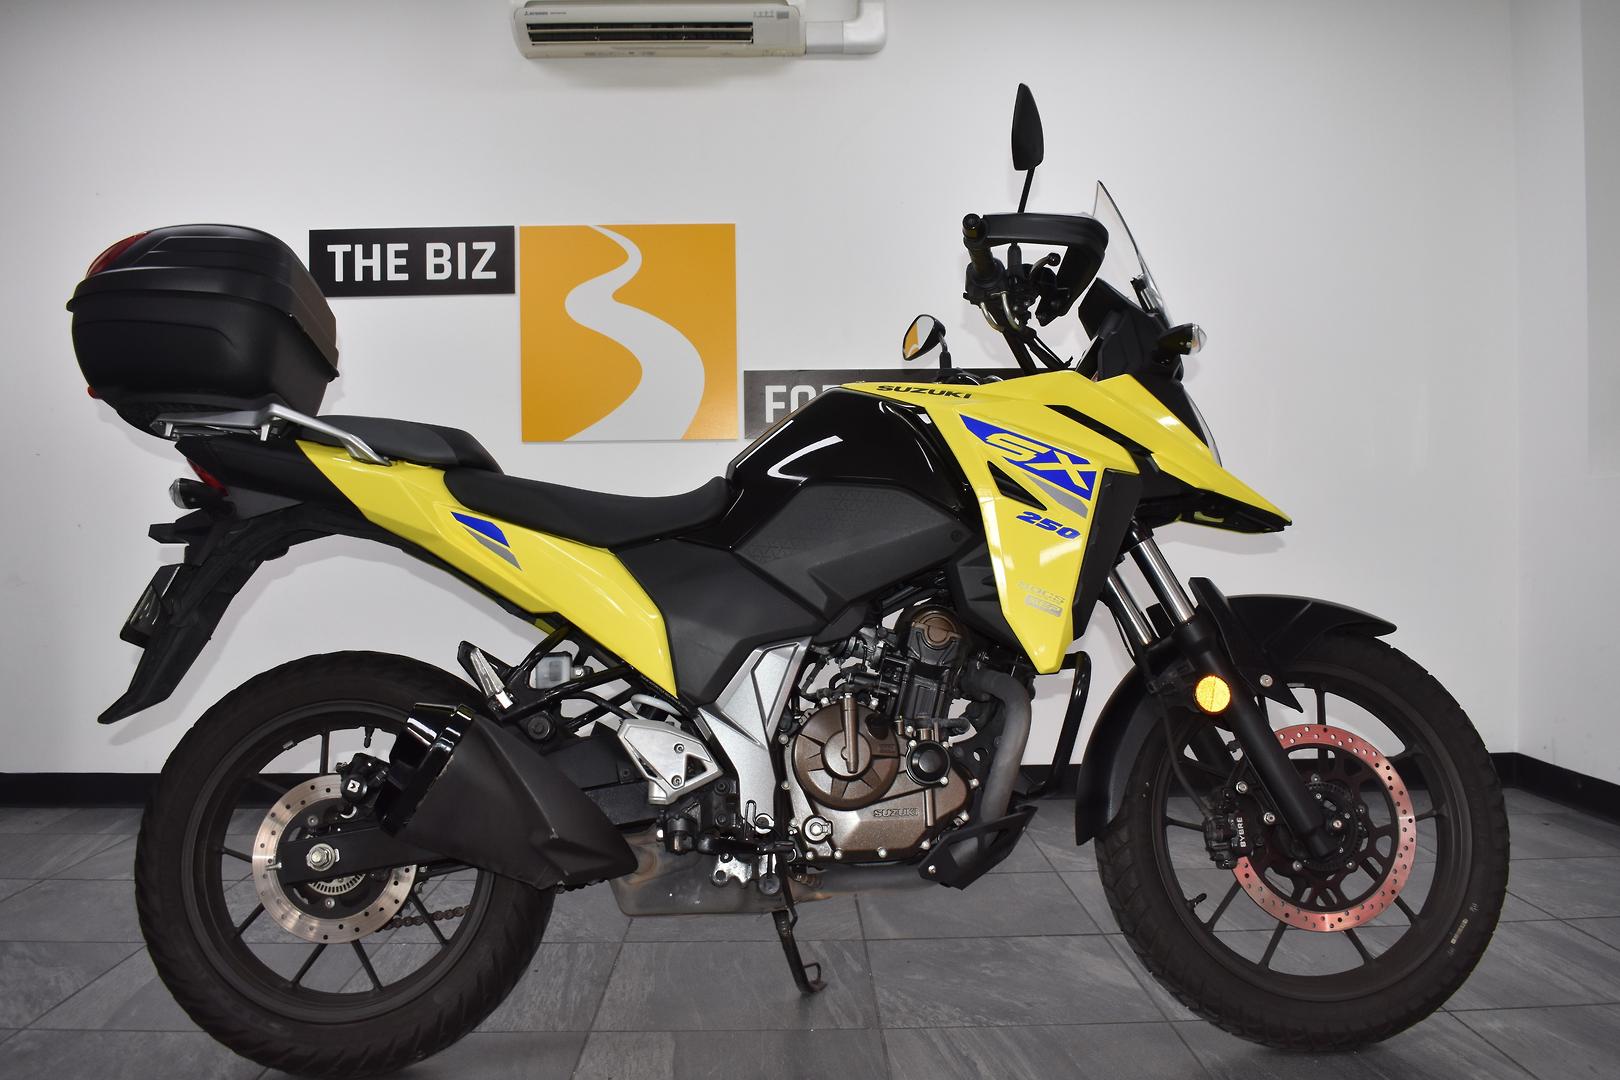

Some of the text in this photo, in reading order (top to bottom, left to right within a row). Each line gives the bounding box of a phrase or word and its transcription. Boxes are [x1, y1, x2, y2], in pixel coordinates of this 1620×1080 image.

[327, 241, 497, 282] THE BIZ
[765, 384, 841, 423] FO
[876, 385, 972, 399] SUZUKI
[985, 433, 1099, 491] SX
[1016, 511, 1080, 539] 250
[873, 807, 920, 818] SUZUKI
[1236, 817, 1247, 847] BYBRE
